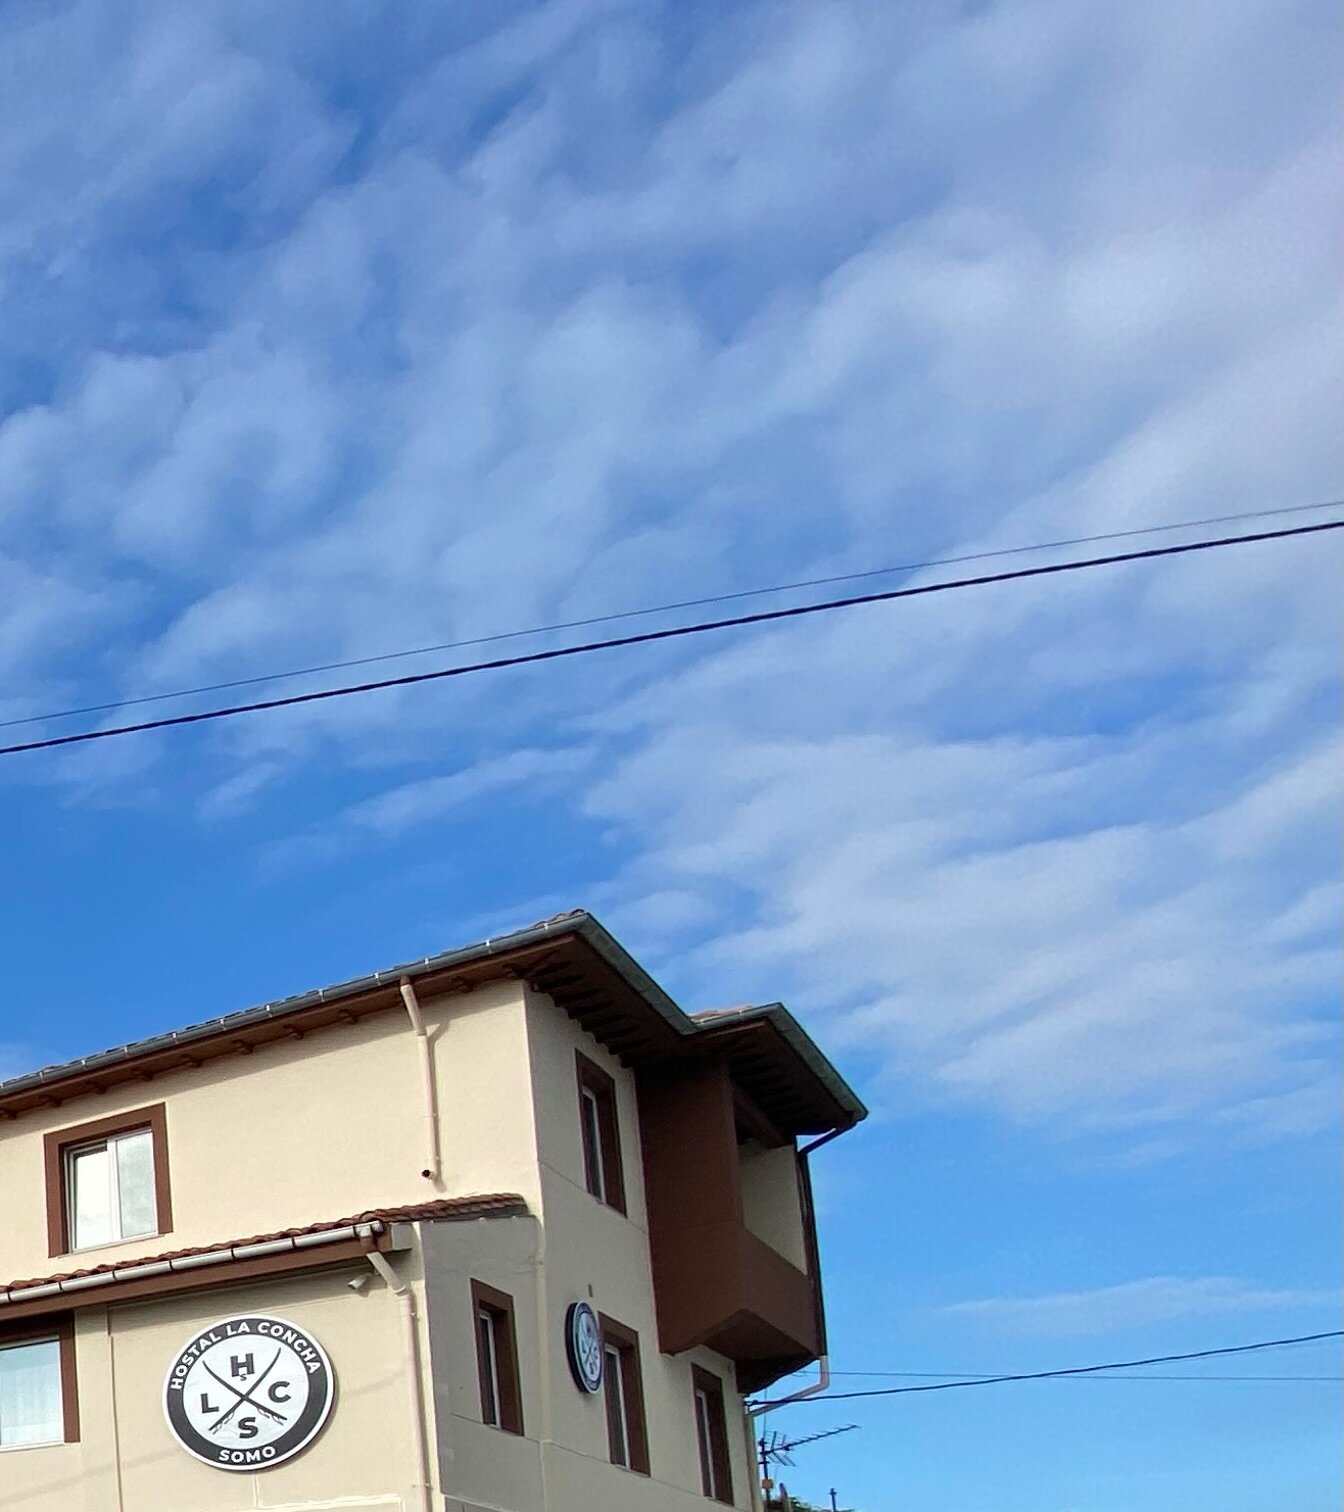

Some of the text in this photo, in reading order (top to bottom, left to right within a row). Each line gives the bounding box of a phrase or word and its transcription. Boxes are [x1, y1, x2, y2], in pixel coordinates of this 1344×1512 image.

[170, 1321, 322, 1389] HOSTAL LA CONCHA
[230, 1353, 255, 1377] H
[200, 1381, 291, 1414] L C
[238, 1416, 259, 1439] S
[219, 1446, 276, 1463] SOMO
